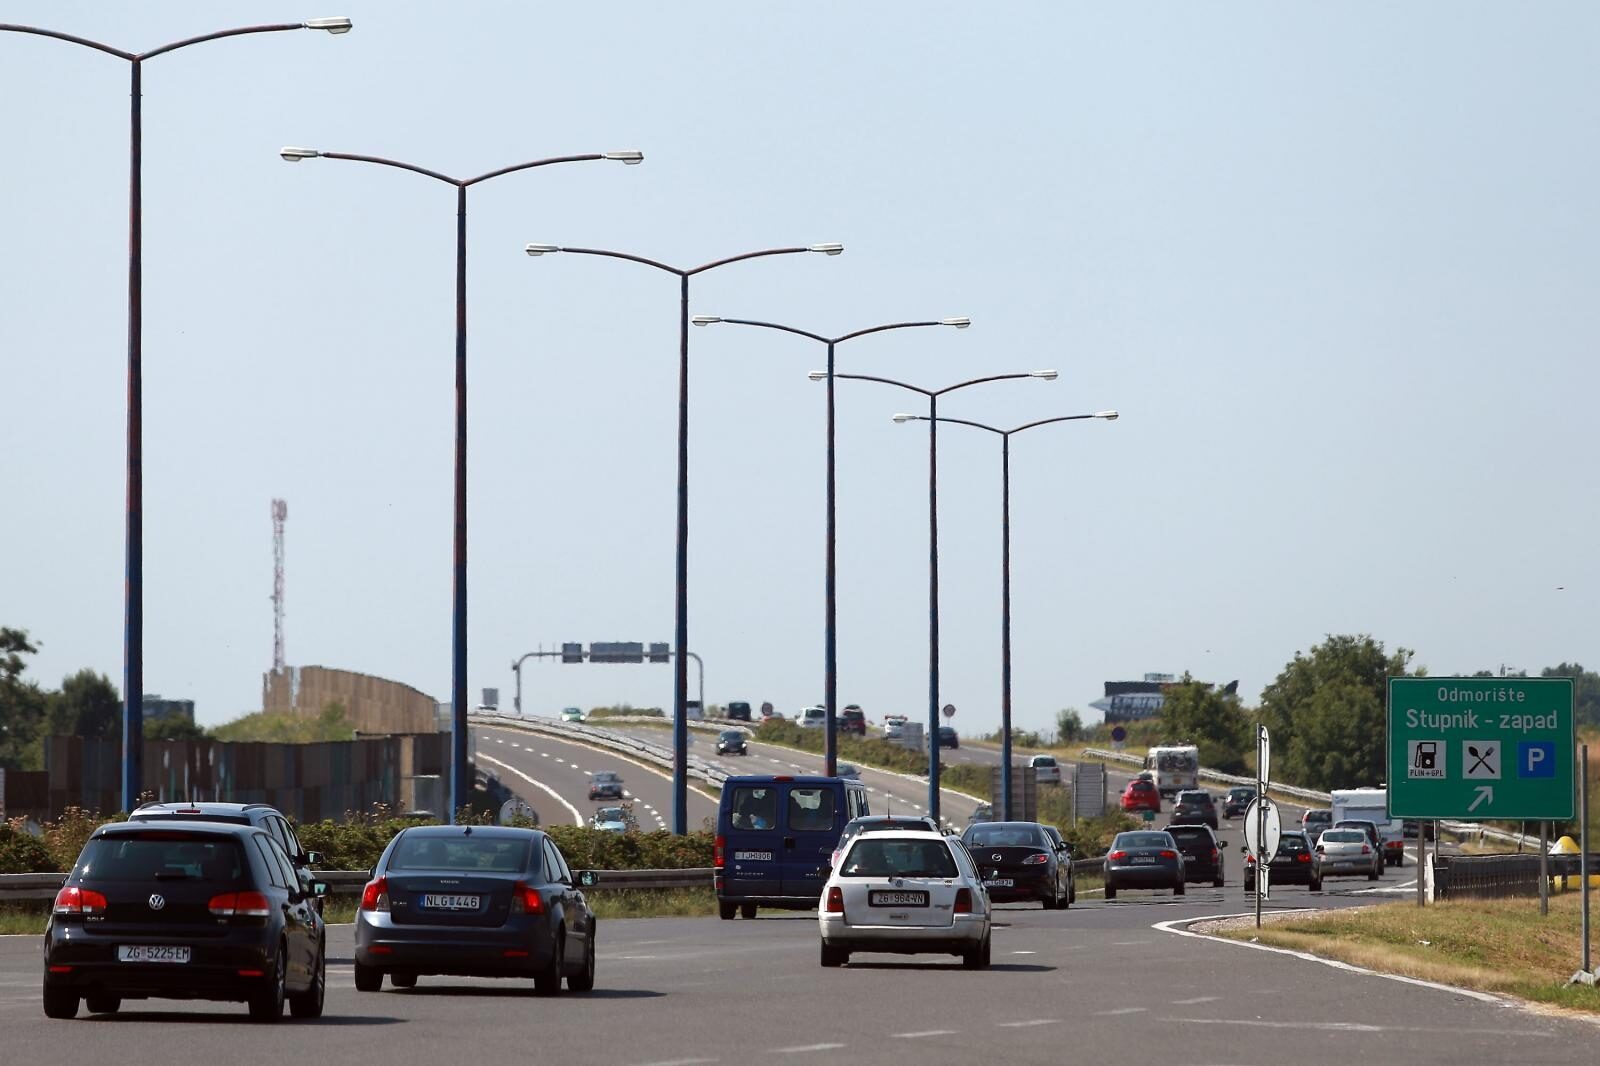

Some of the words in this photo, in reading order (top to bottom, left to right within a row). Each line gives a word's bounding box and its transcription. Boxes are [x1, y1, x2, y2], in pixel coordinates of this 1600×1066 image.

[1438, 687, 1525, 702] Odmorište
[1406, 708, 1479, 733] Stupnik
[1500, 709, 1558, 734] zapad
[1528, 748, 1545, 771] P
[426, 895, 448, 906] NLG
[456, 896, 478, 908] 446
[127, 946, 141, 959] ZG
